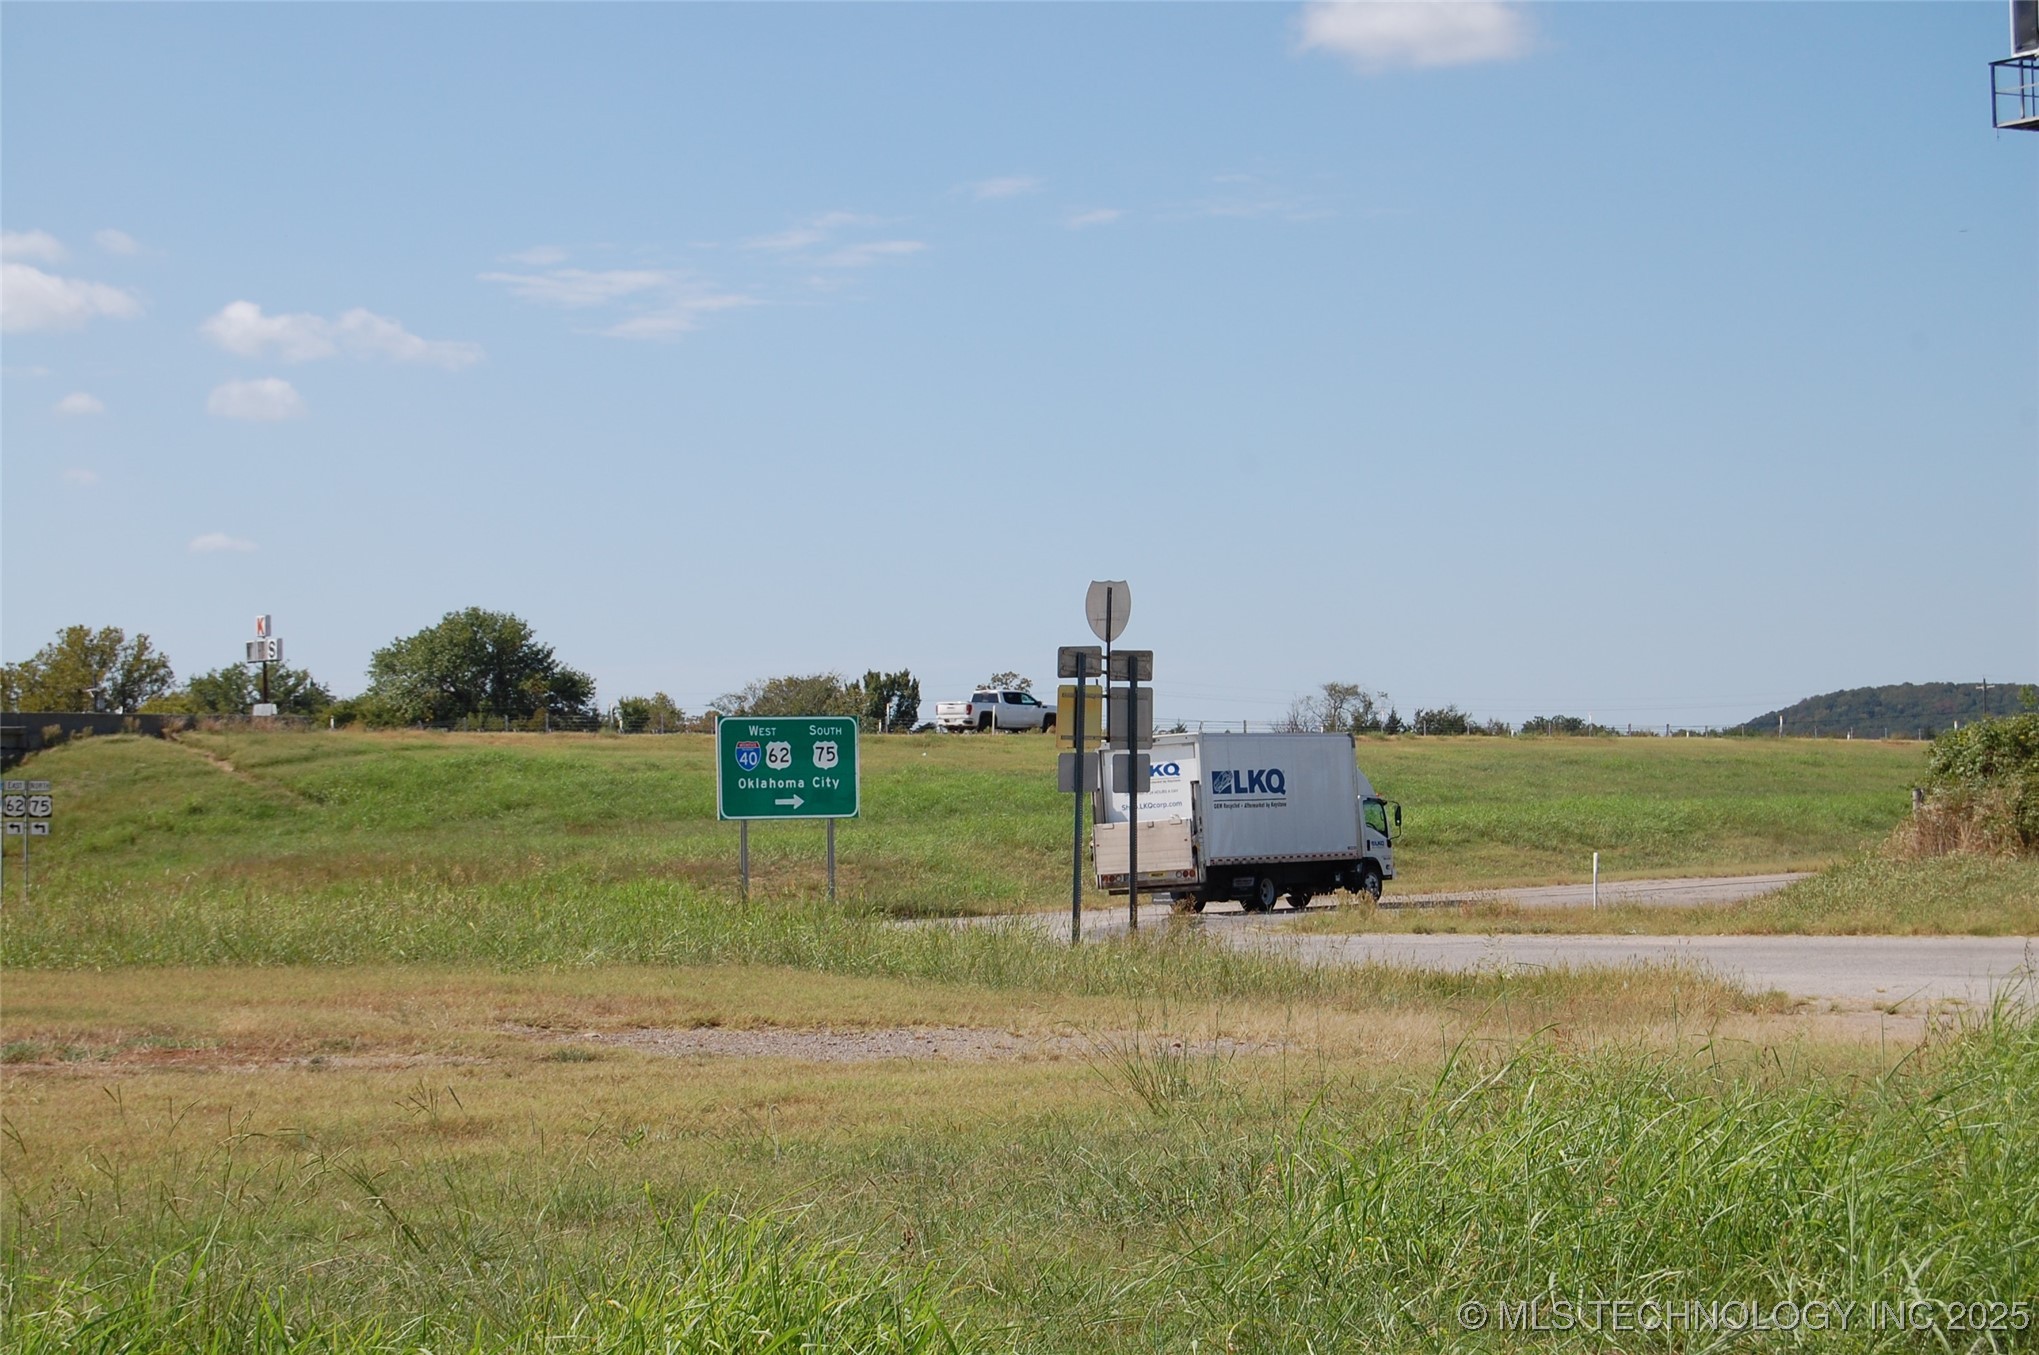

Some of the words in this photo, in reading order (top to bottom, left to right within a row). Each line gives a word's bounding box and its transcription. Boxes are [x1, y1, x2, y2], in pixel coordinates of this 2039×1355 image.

[256, 617, 264, 635] K
[739, 752, 758, 766] 40
[768, 747, 789, 763] 62
[815, 746, 836, 762] 75
[1149, 762, 1181, 777] KQ
[738, 777, 805, 790] Oklahoma
[812, 776, 840, 790] City
[1233, 768, 1286, 795] LKQ
[6, 800, 24, 812] 62
[31, 800, 50, 812] 75
